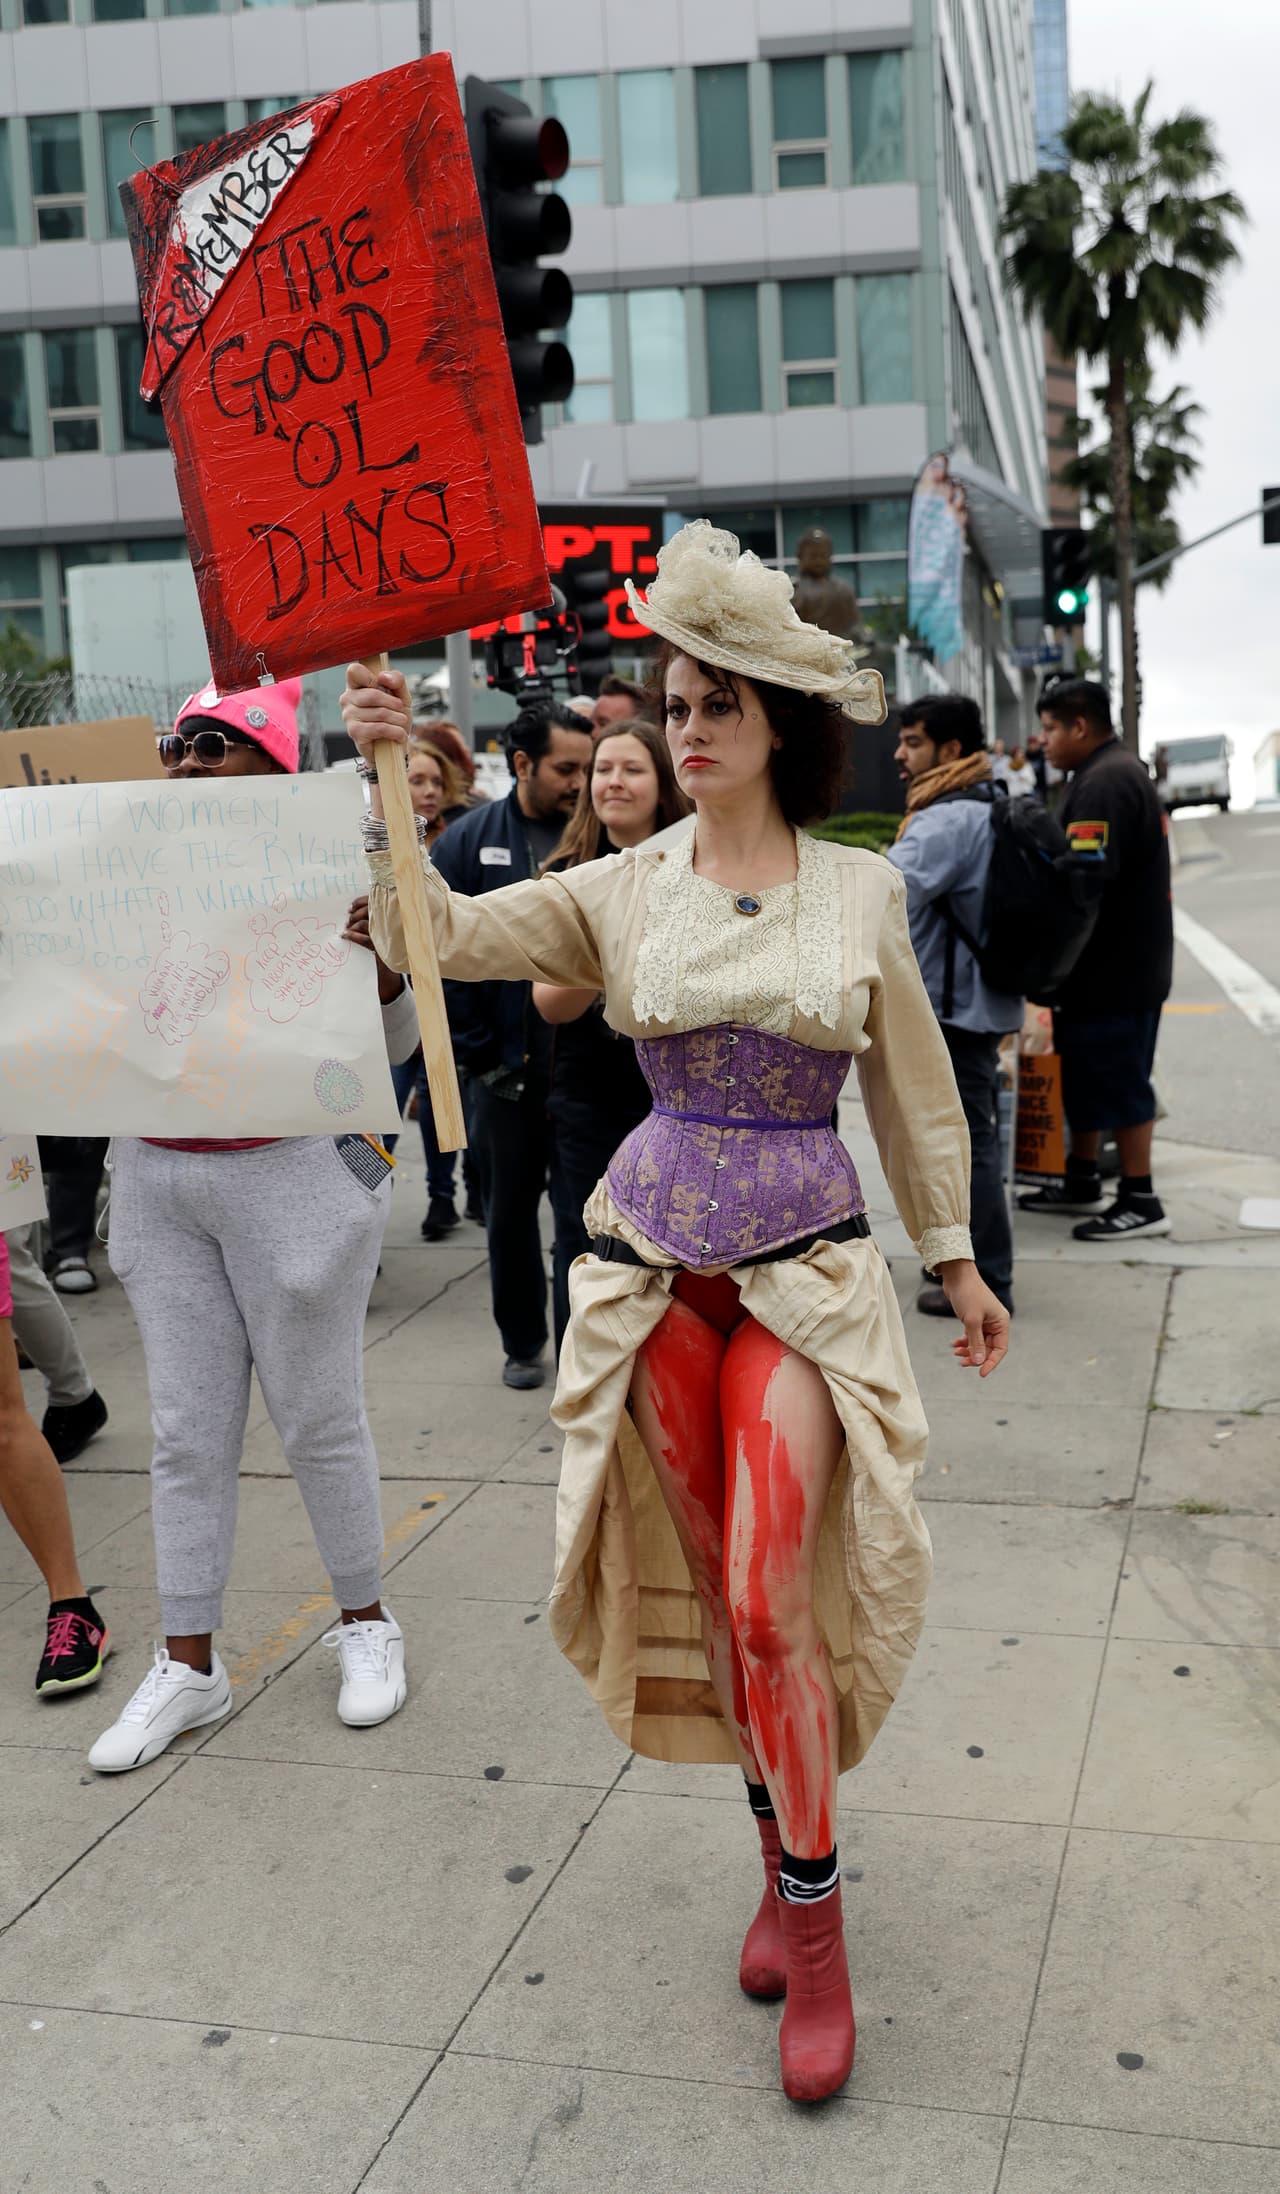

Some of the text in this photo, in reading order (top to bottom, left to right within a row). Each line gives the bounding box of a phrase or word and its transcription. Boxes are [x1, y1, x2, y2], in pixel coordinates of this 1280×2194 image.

[151, 131, 312, 378] REMEMBER
[210, 302, 391, 435] GOOD
[248, 482, 456, 621] DAYS
[68, 787, 102, 837] A
[79, 846, 169, 882] HAVE
[180, 839, 246, 873] THE
[250, 831, 362, 877] RIGHT
[16, 895, 58, 922] DO
[70, 886, 162, 921] WHAT
[176, 885, 183, 912] I
[196, 875, 280, 912] WANT
[292, 872, 359, 902] WITH
